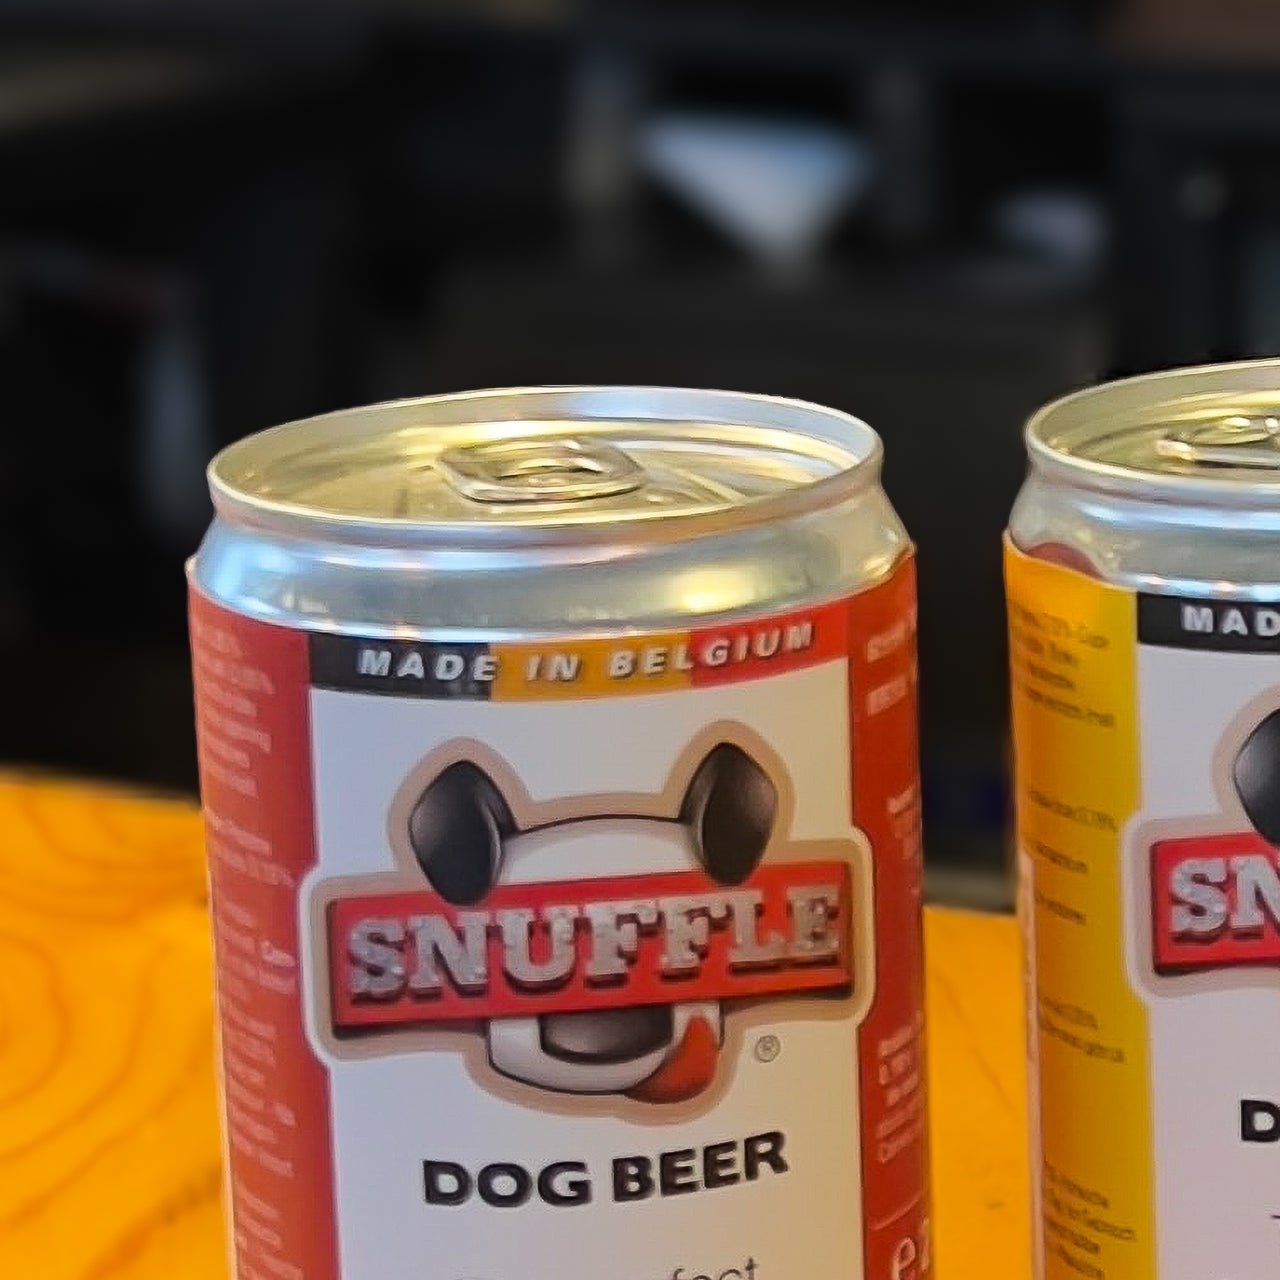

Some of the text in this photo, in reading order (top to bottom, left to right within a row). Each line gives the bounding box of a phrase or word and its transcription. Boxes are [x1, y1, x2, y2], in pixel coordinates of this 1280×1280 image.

[355, 622, 814, 683] MADE IN BELGIUM
[346, 882, 842, 1004] SNUFFLE
[422, 1131, 788, 1207] DOG BEER
